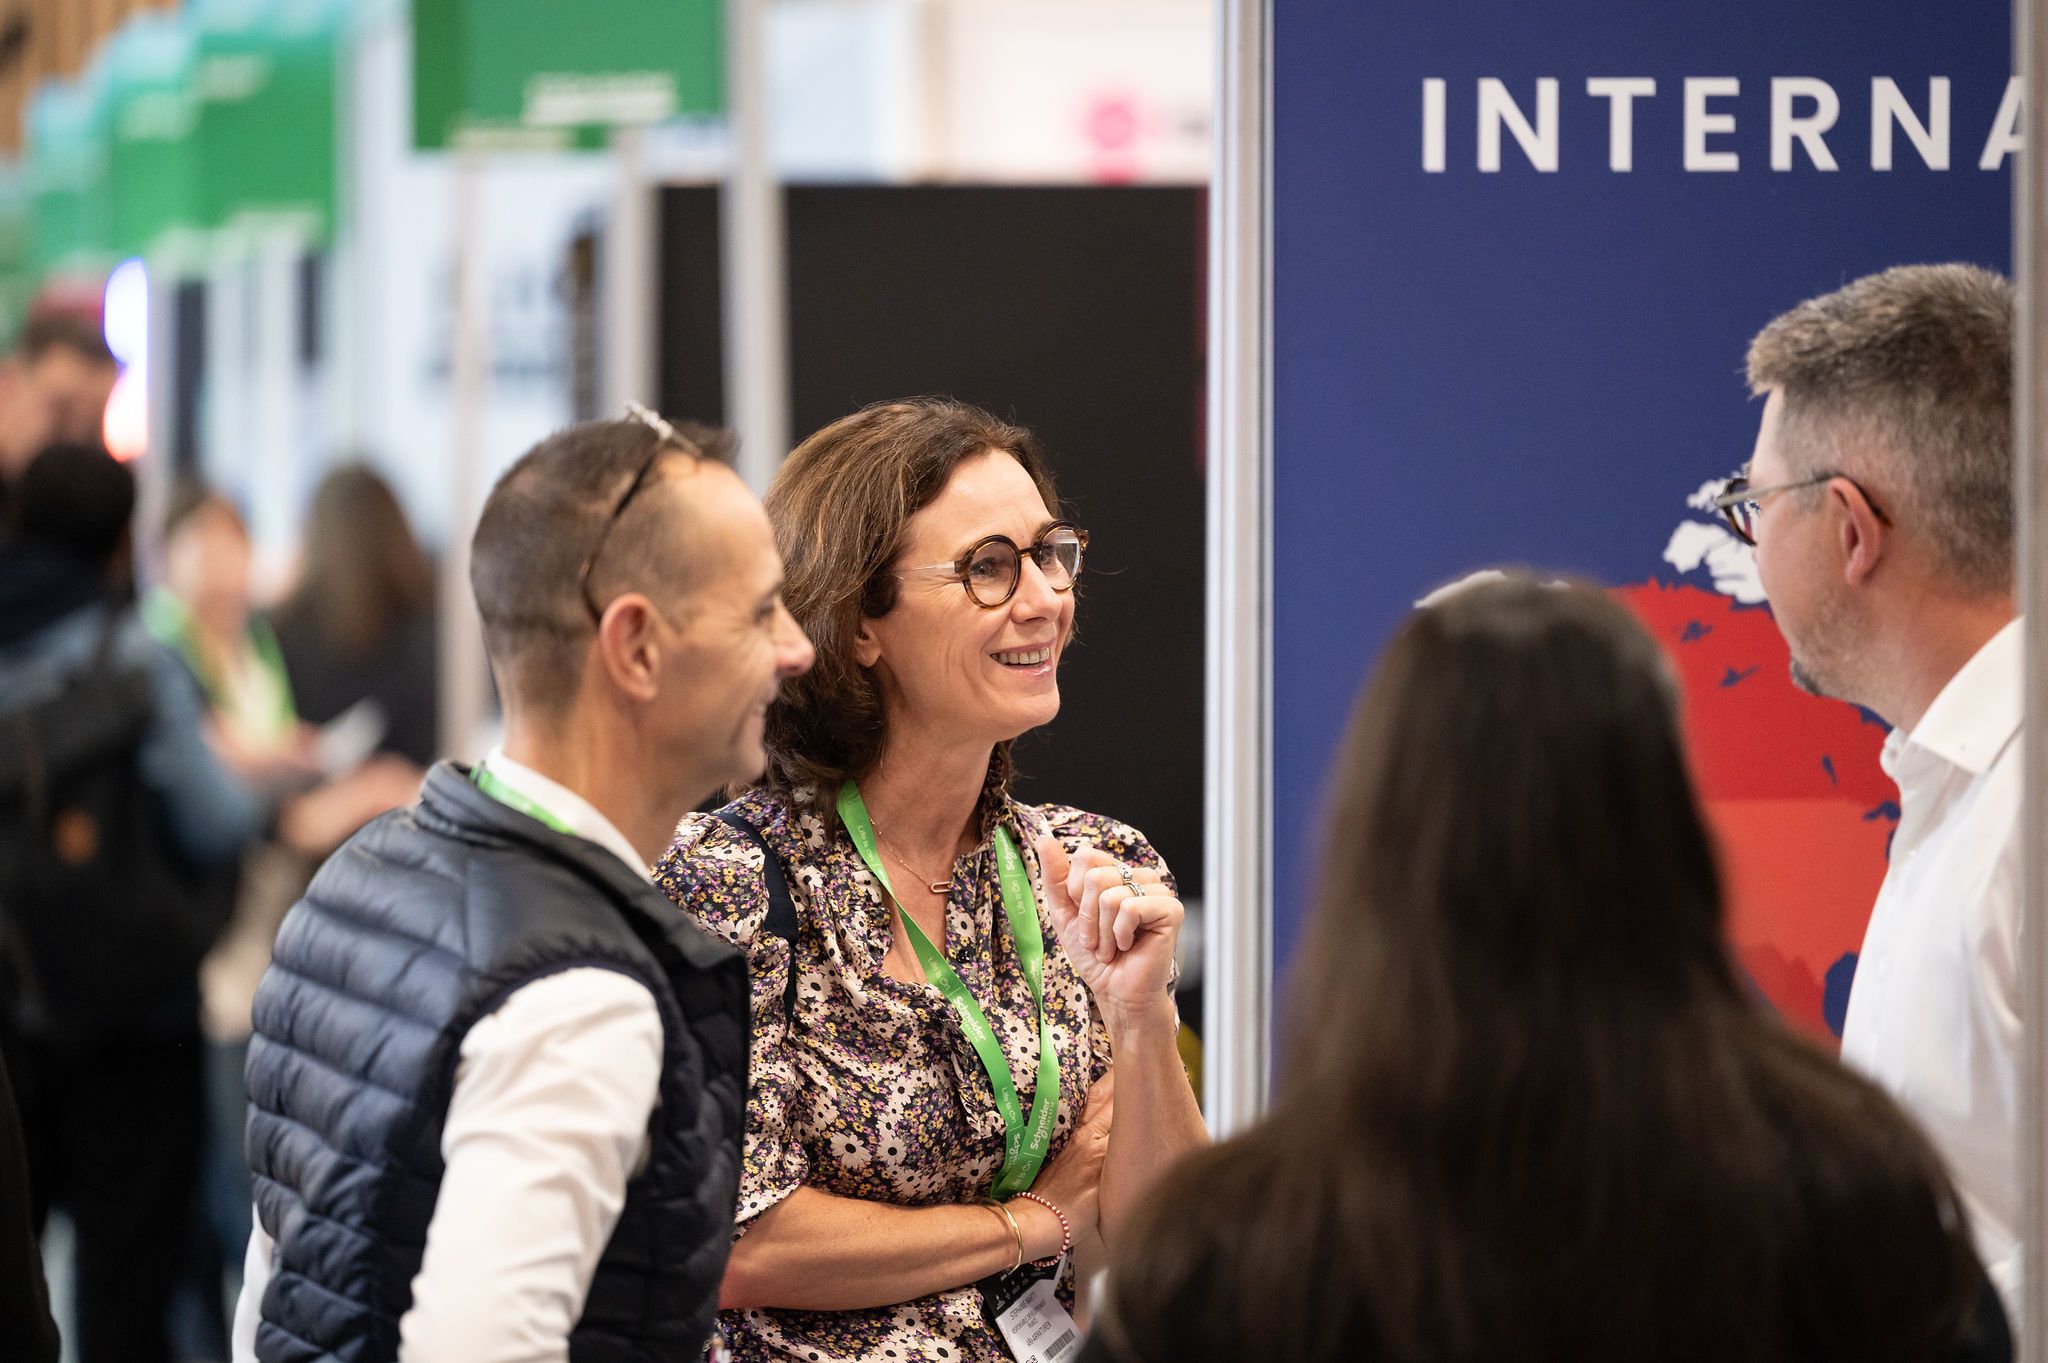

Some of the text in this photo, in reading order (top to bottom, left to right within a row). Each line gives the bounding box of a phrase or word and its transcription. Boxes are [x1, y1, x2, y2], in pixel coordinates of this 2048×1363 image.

[1422, 76, 2025, 173] INTERNA
[953, 995, 987, 1041] Schneider
[1030, 1098, 1050, 1151] Schneider
